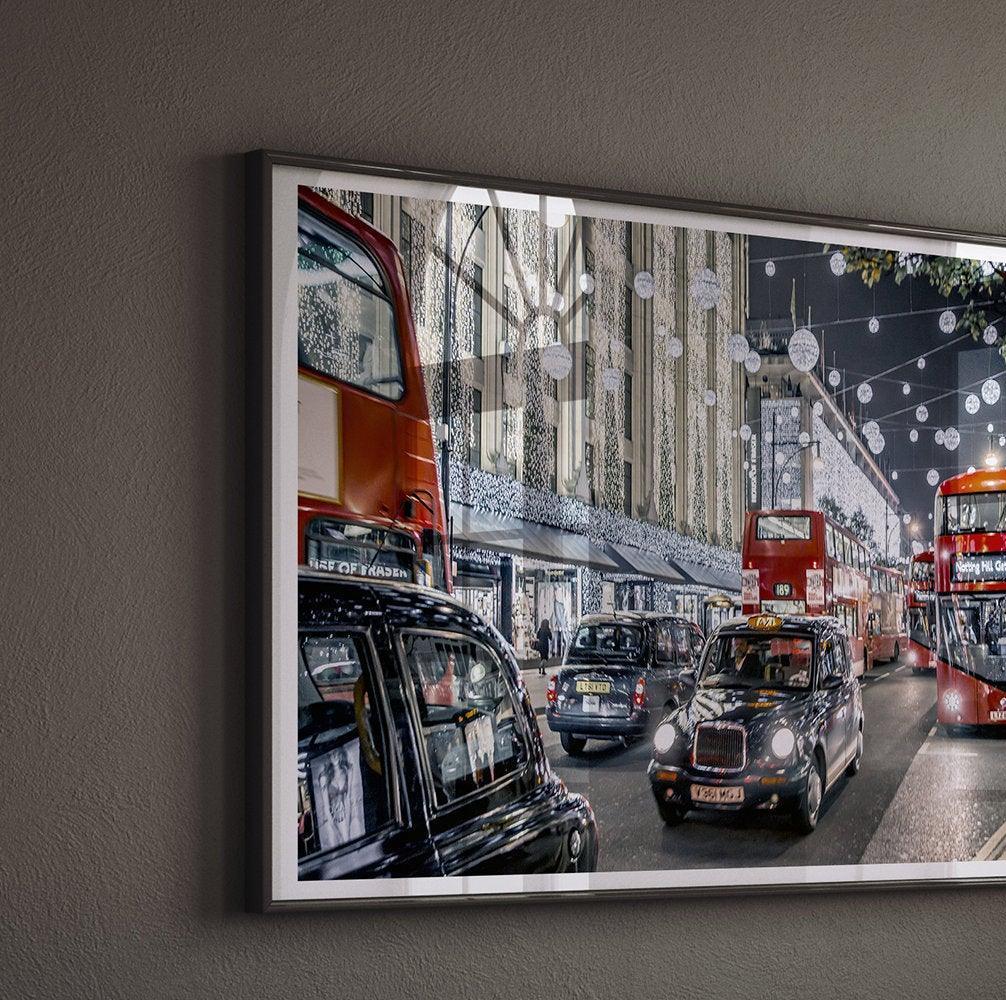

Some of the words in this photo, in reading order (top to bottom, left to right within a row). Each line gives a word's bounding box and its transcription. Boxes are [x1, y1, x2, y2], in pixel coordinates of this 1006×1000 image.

[338, 560, 358, 575] OF
[955, 560, 980, 575] Notting
[981, 560, 993, 572] Hill
[776, 584, 790, 596] 189
